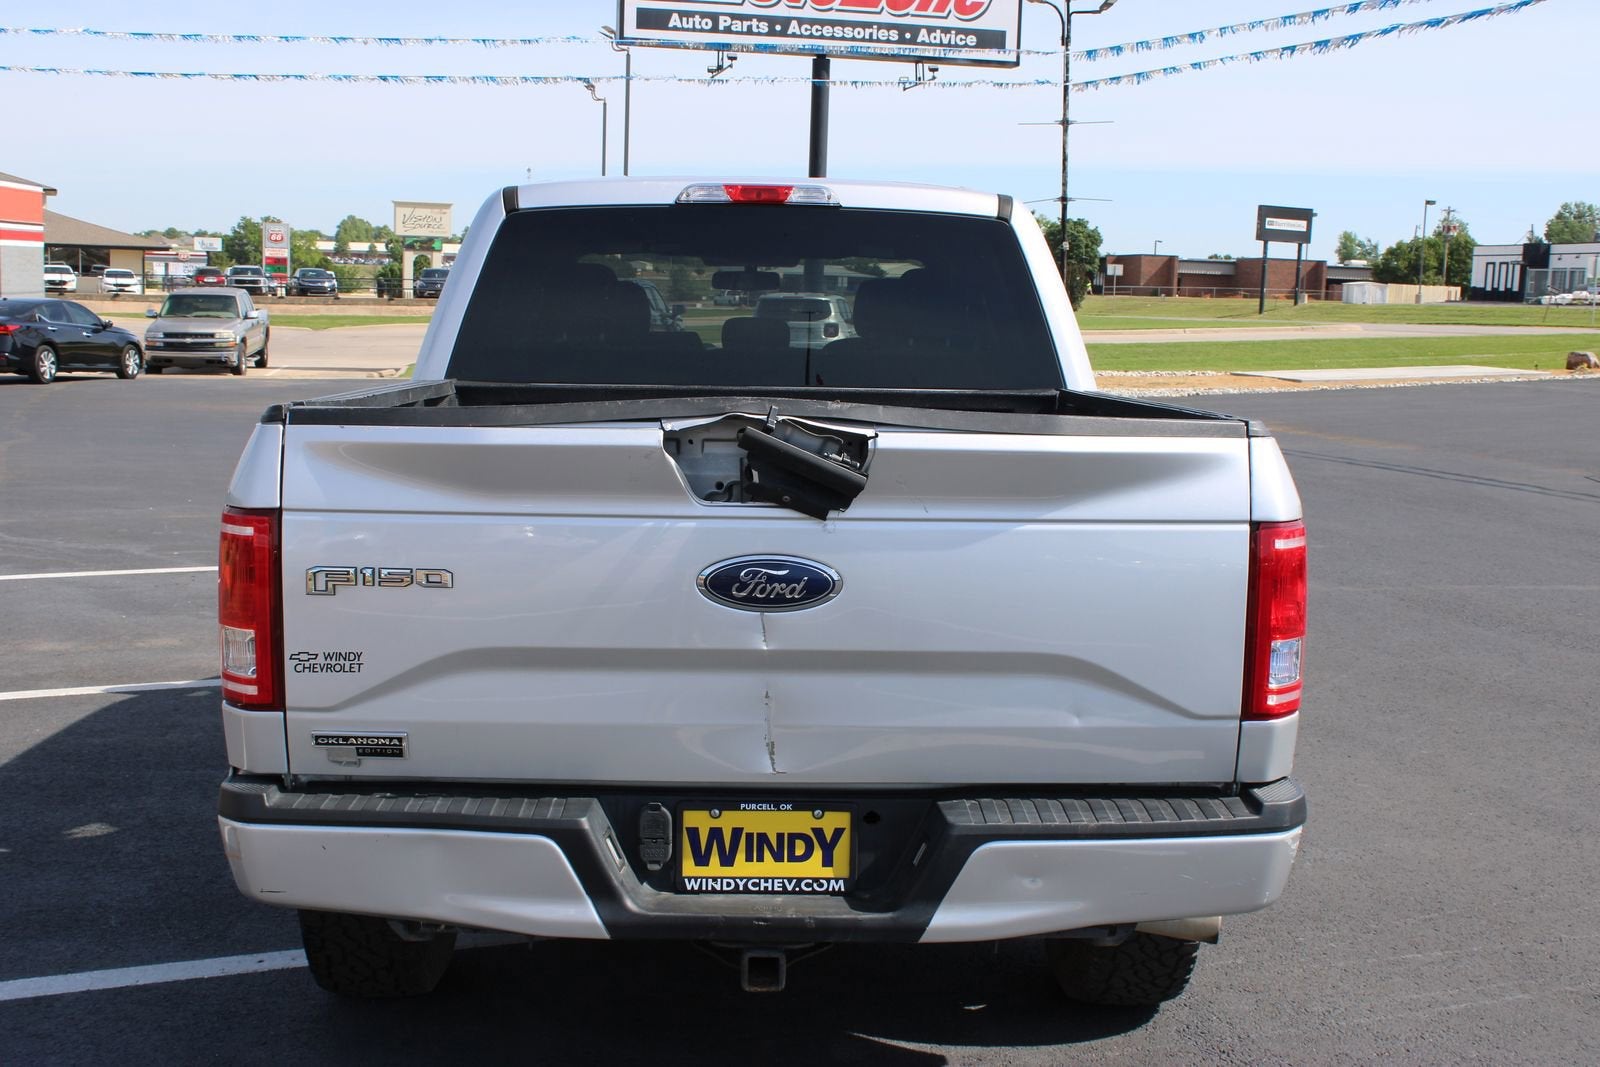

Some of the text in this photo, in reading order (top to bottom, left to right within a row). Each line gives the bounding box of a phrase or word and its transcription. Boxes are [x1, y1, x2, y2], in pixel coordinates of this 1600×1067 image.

[668, 12, 977, 46] Auto Parts Accessories Advice
[306, 565, 454, 596] F150
[731, 567, 809, 599] Ford
[323, 651, 363, 662] WINDY
[294, 662, 364, 674] CHEVROLET
[316, 736, 400, 746] OKLAHOMA
[740, 803, 793, 811] PURCELL, OK
[684, 878, 845, 892] WINDYCHEV.COM
